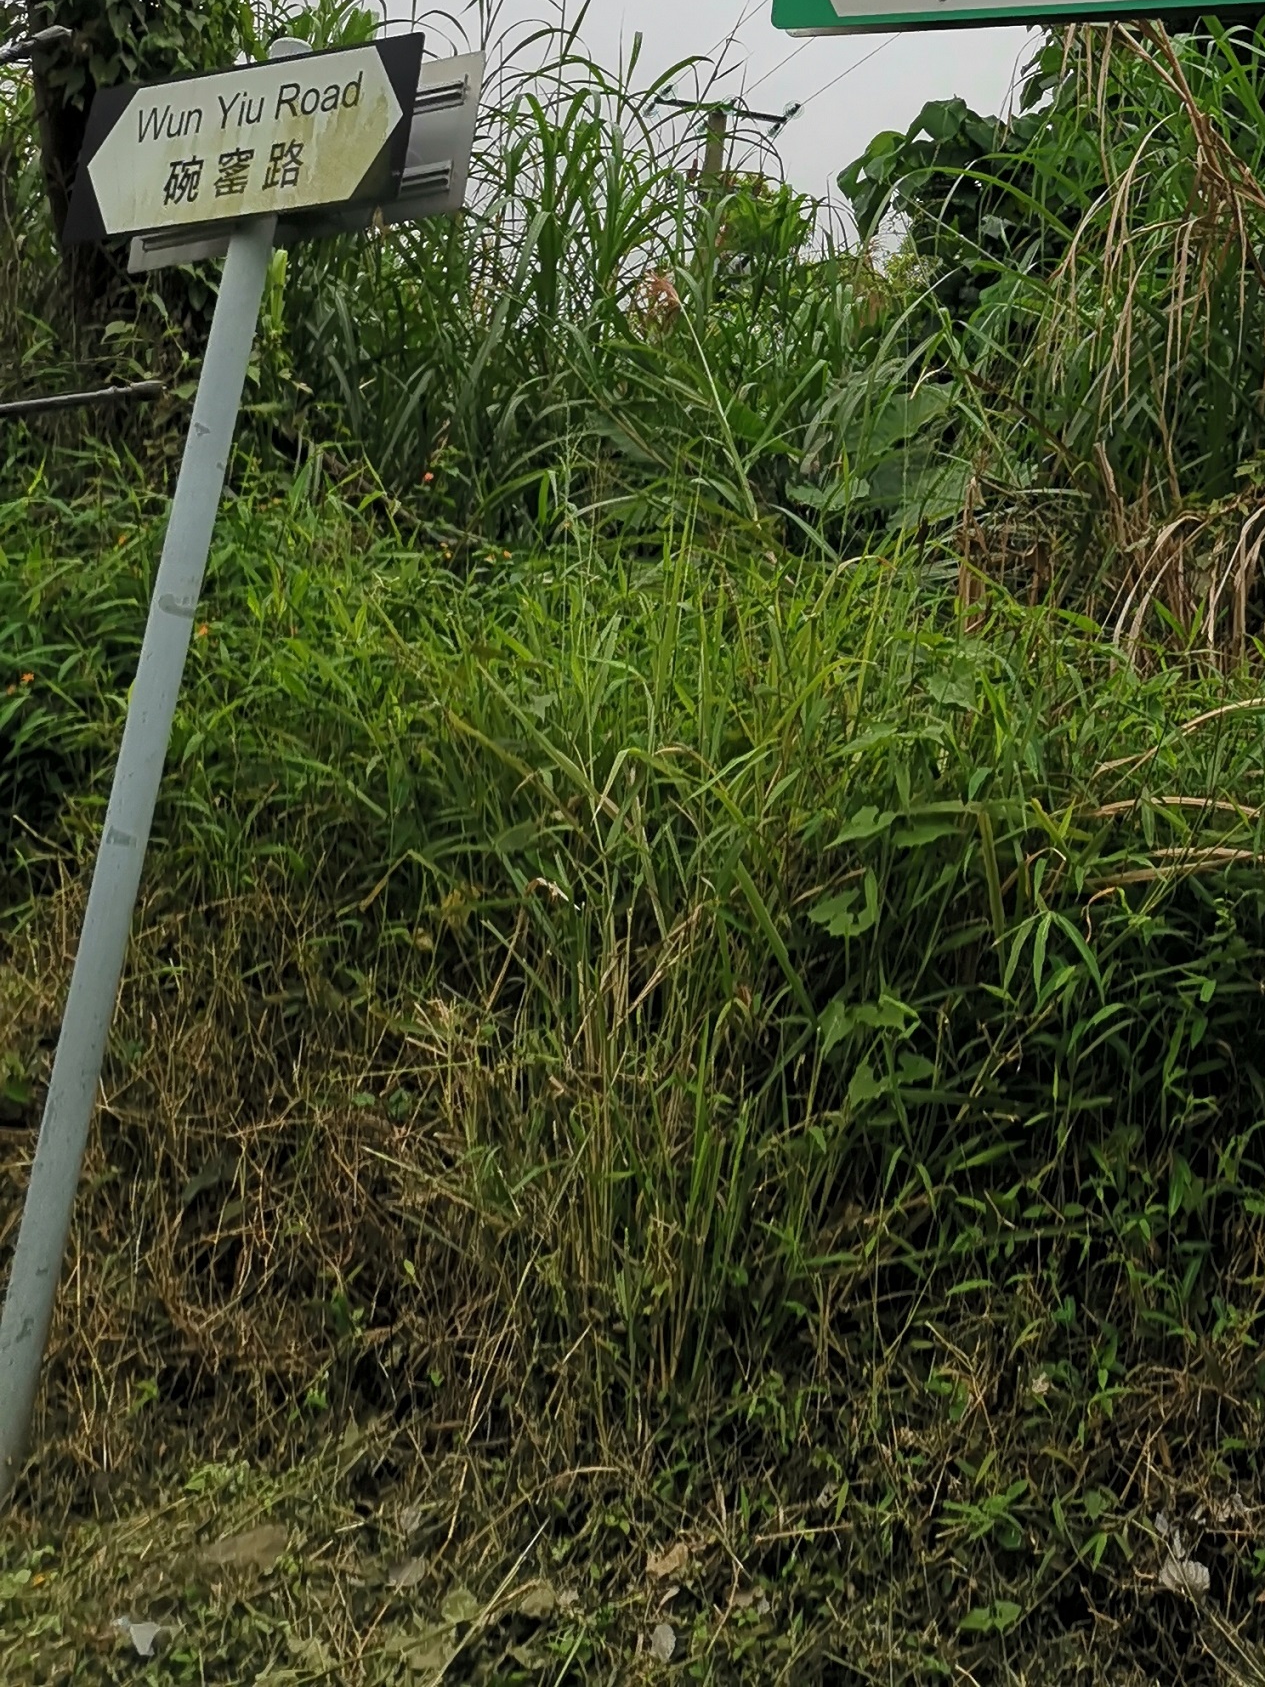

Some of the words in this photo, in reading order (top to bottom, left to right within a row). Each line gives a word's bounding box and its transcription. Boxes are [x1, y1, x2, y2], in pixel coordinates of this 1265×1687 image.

[138, 105, 203, 143] Wun
[218, 92, 265, 129] Yiu
[275, 71, 363, 120] Road
